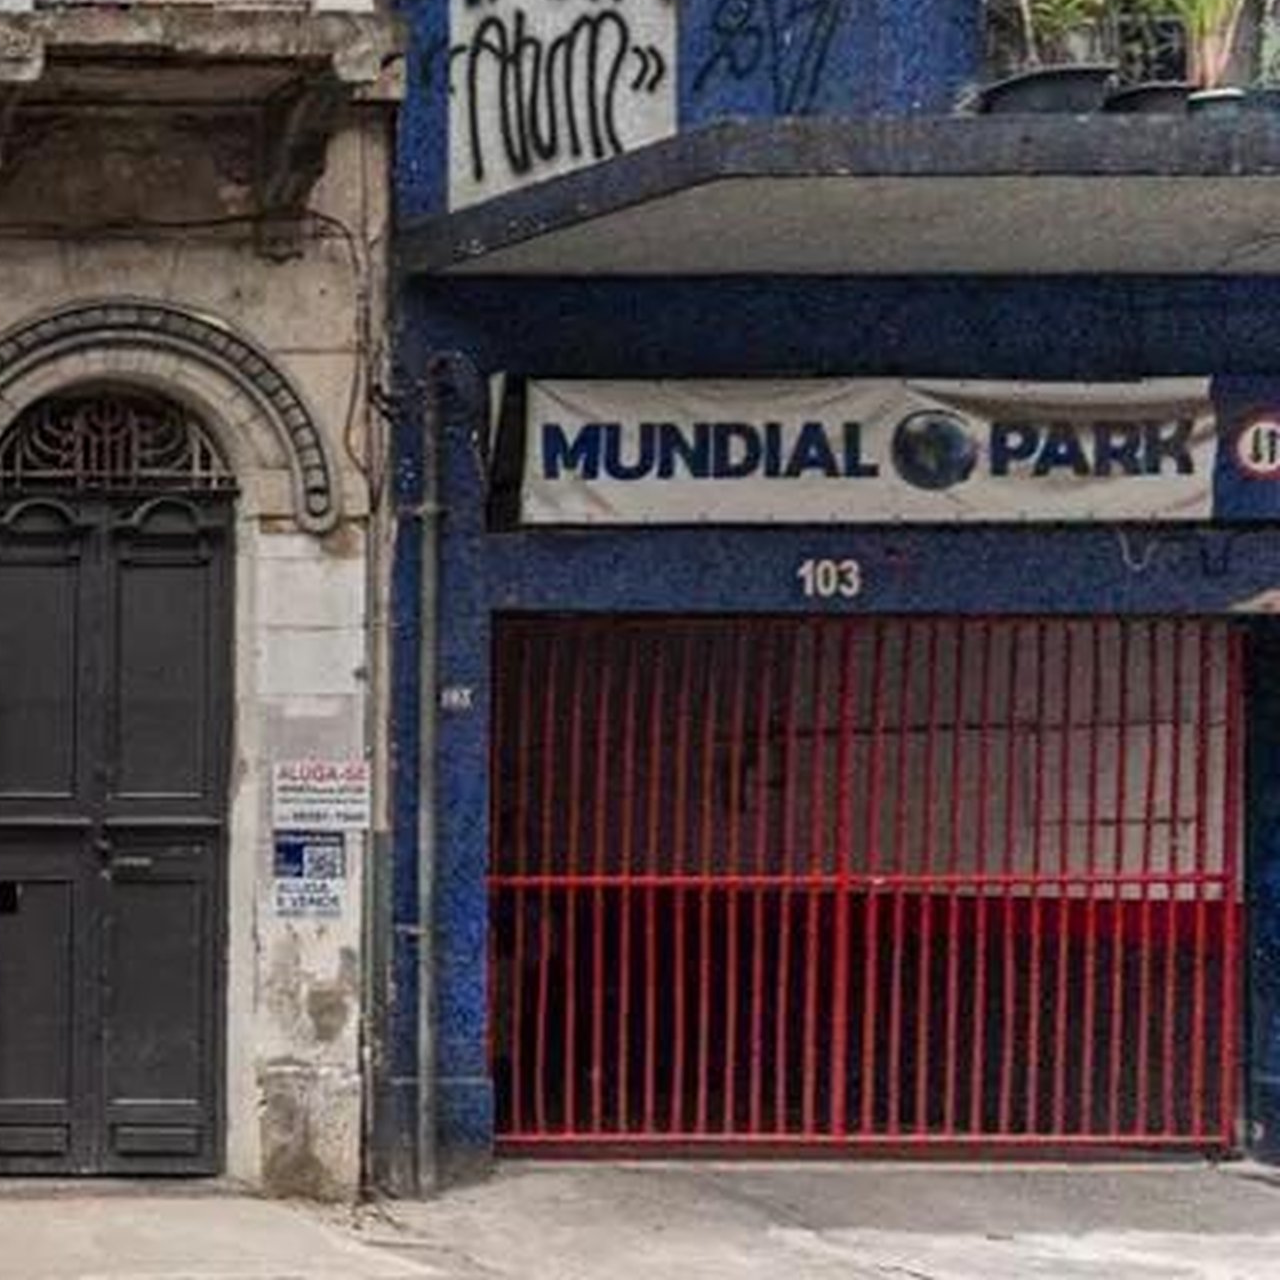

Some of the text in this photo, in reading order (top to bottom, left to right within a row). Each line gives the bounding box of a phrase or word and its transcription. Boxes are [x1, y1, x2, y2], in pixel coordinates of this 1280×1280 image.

[541, 417, 1195, 480] MUNDIAL PARK
[796, 559, 860, 596] 103
